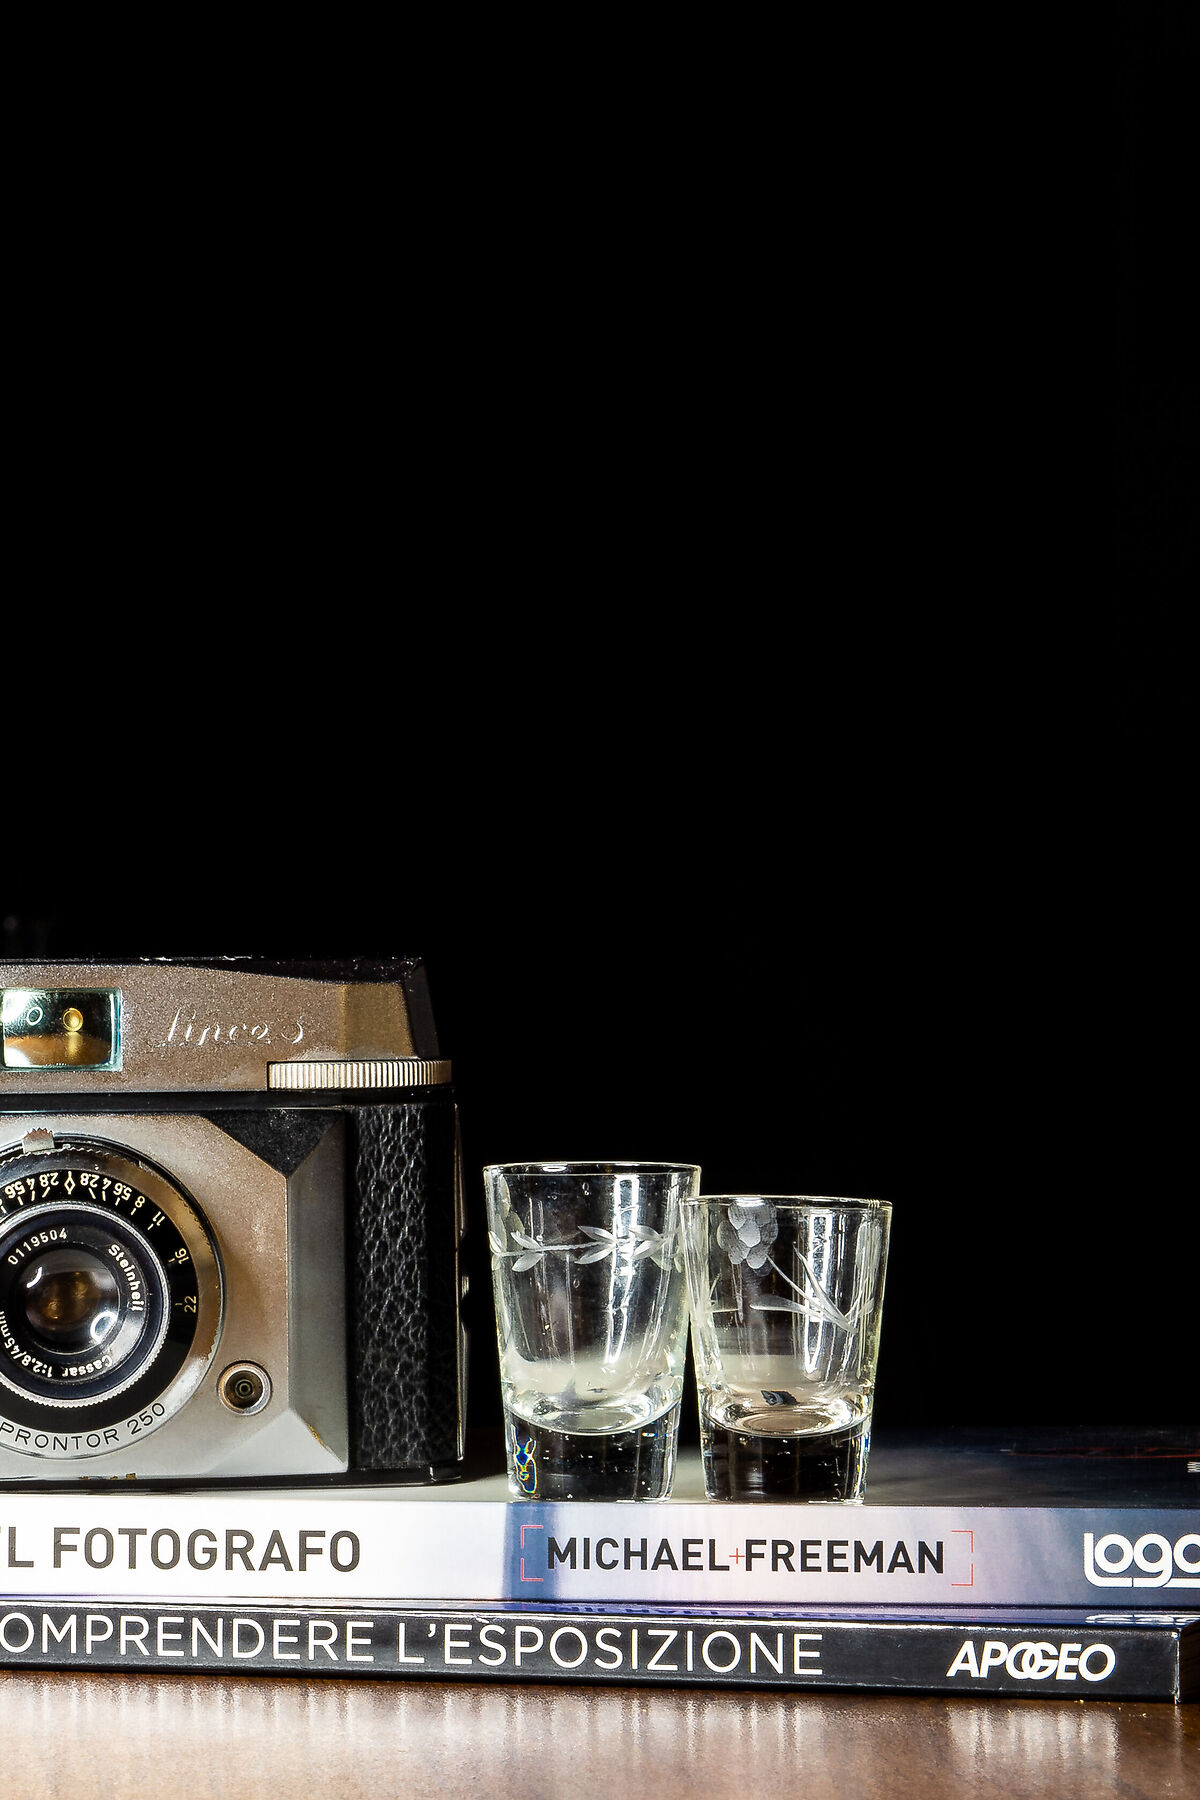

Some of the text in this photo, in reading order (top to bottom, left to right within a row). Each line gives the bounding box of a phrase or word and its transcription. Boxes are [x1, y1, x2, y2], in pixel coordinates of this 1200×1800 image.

[5, 1181, 26, 1199] 5.6
[26, 1178, 36, 1190] 4
[39, 1172, 59, 1187] 2.8
[7, 1227, 67, 1265] 0119504
[80, 1172, 197, 1314] 2.8 4 5.6 8 11 16 22
[108, 1243, 145, 1311] Steinheil
[62, 1354, 113, 1377] Cassar
[127, 1402, 165, 1435] 250
[54, 1527, 360, 1573] FOTOGRAFO
[547, 1537, 944, 1573] MICHAEL FREEMAN
[399, 1621, 823, 1676] L'ESPOSIZIONE
[946, 1641, 1116, 1681] APOGEO
